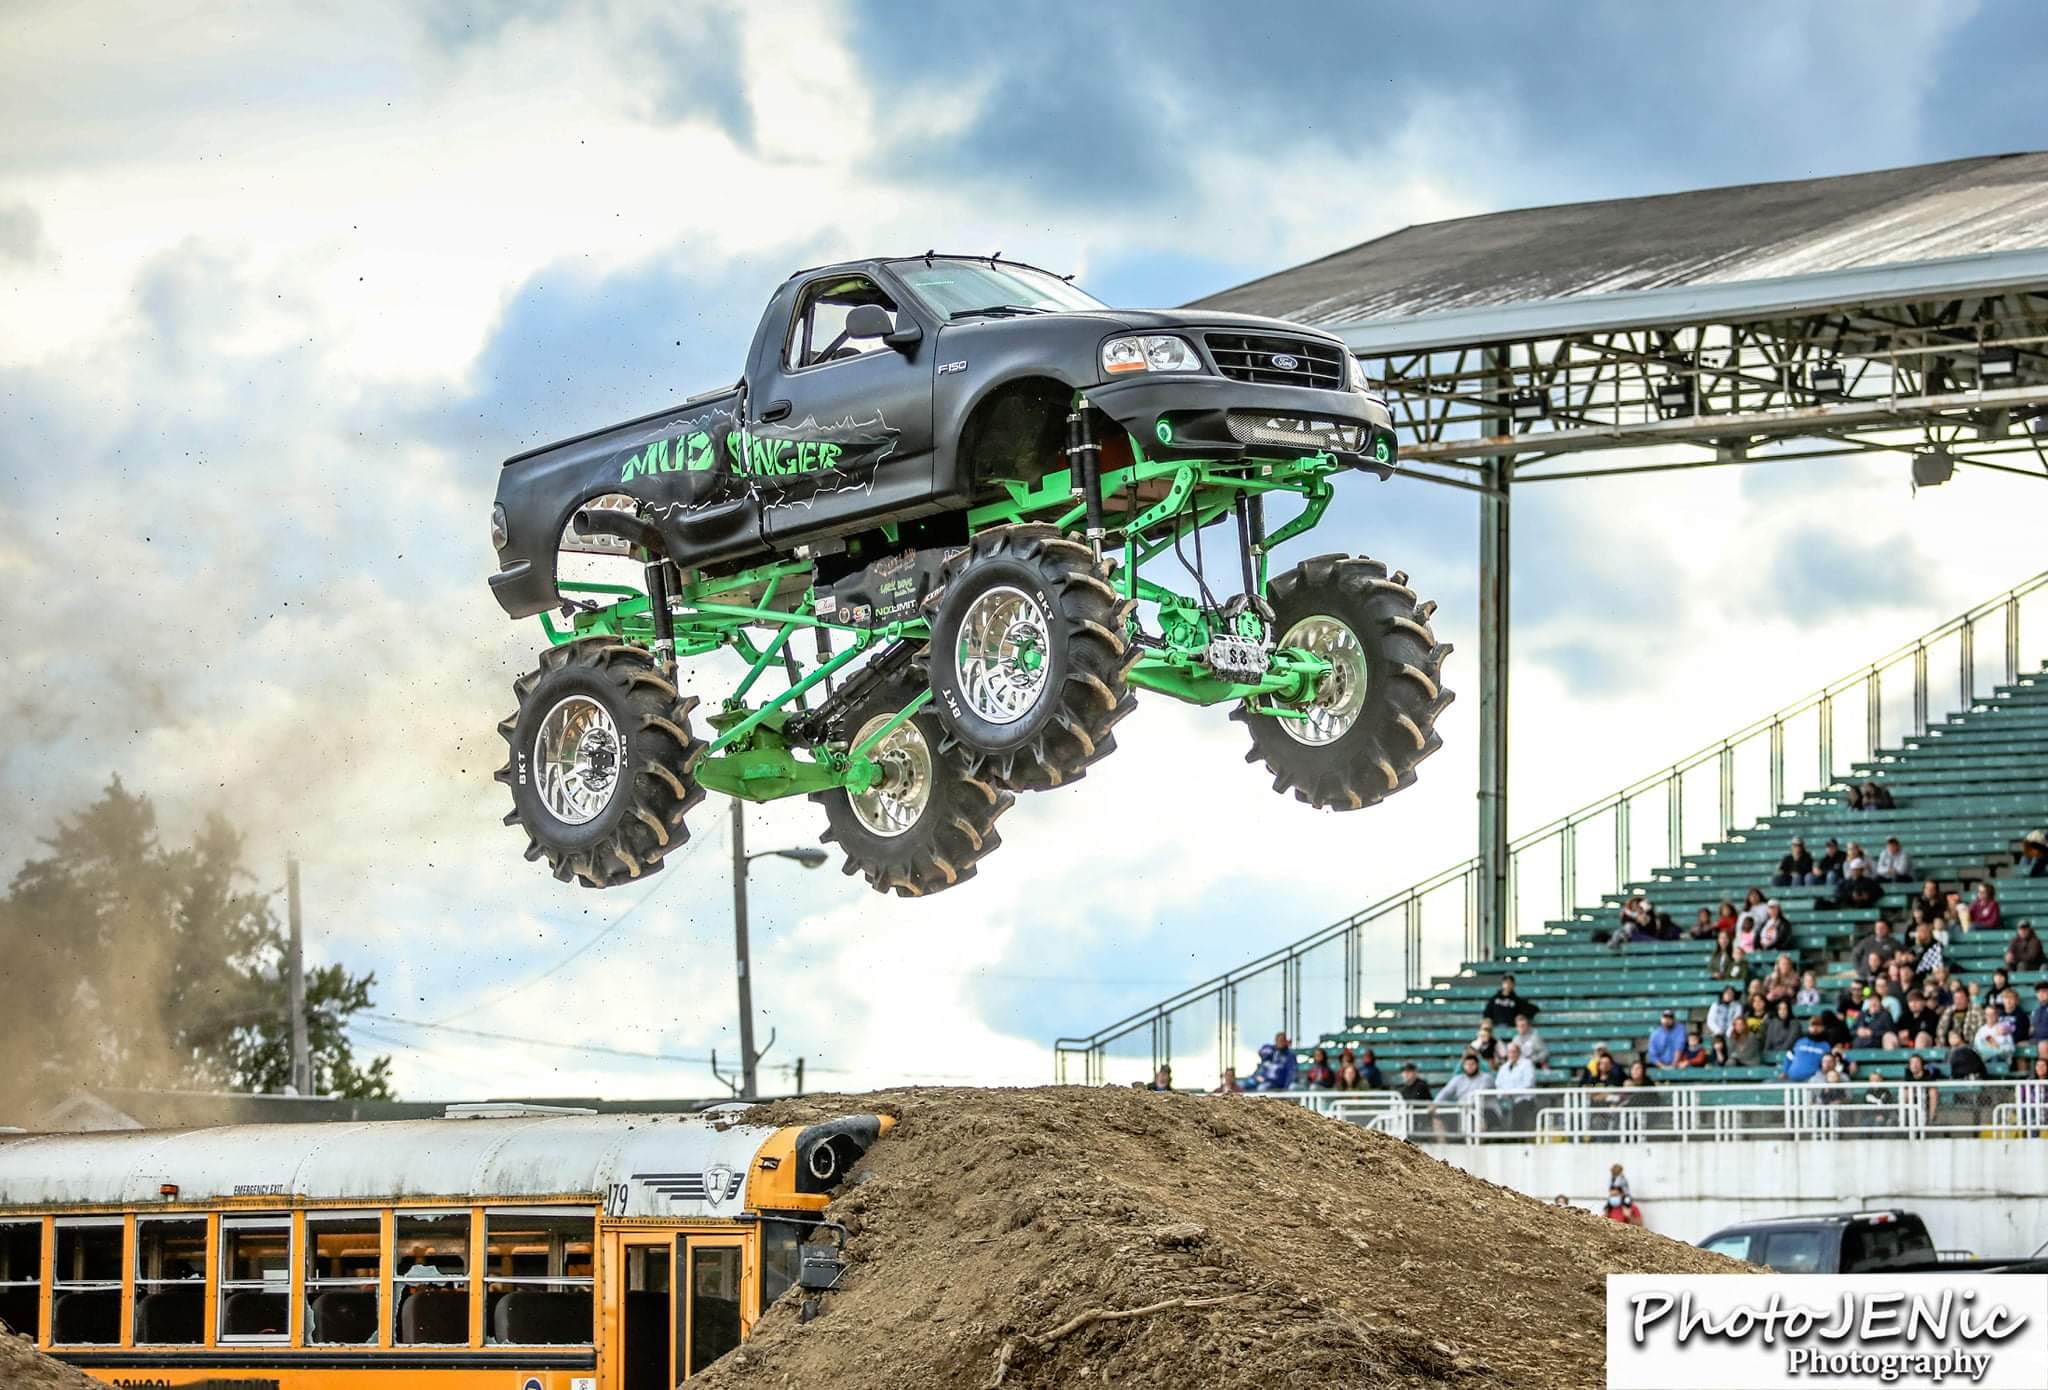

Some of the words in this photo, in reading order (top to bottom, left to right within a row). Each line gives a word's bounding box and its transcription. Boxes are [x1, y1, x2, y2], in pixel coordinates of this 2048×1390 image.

[621, 431, 715, 482] MUD
[1036, 590, 1055, 621] BKT
[942, 688, 962, 719] BKT
[620, 734, 629, 768] BKT
[518, 751, 528, 785] BKT
[233, 1184, 269, 1193] EMERGENCY
[270, 1183, 283, 1193] EXIT
